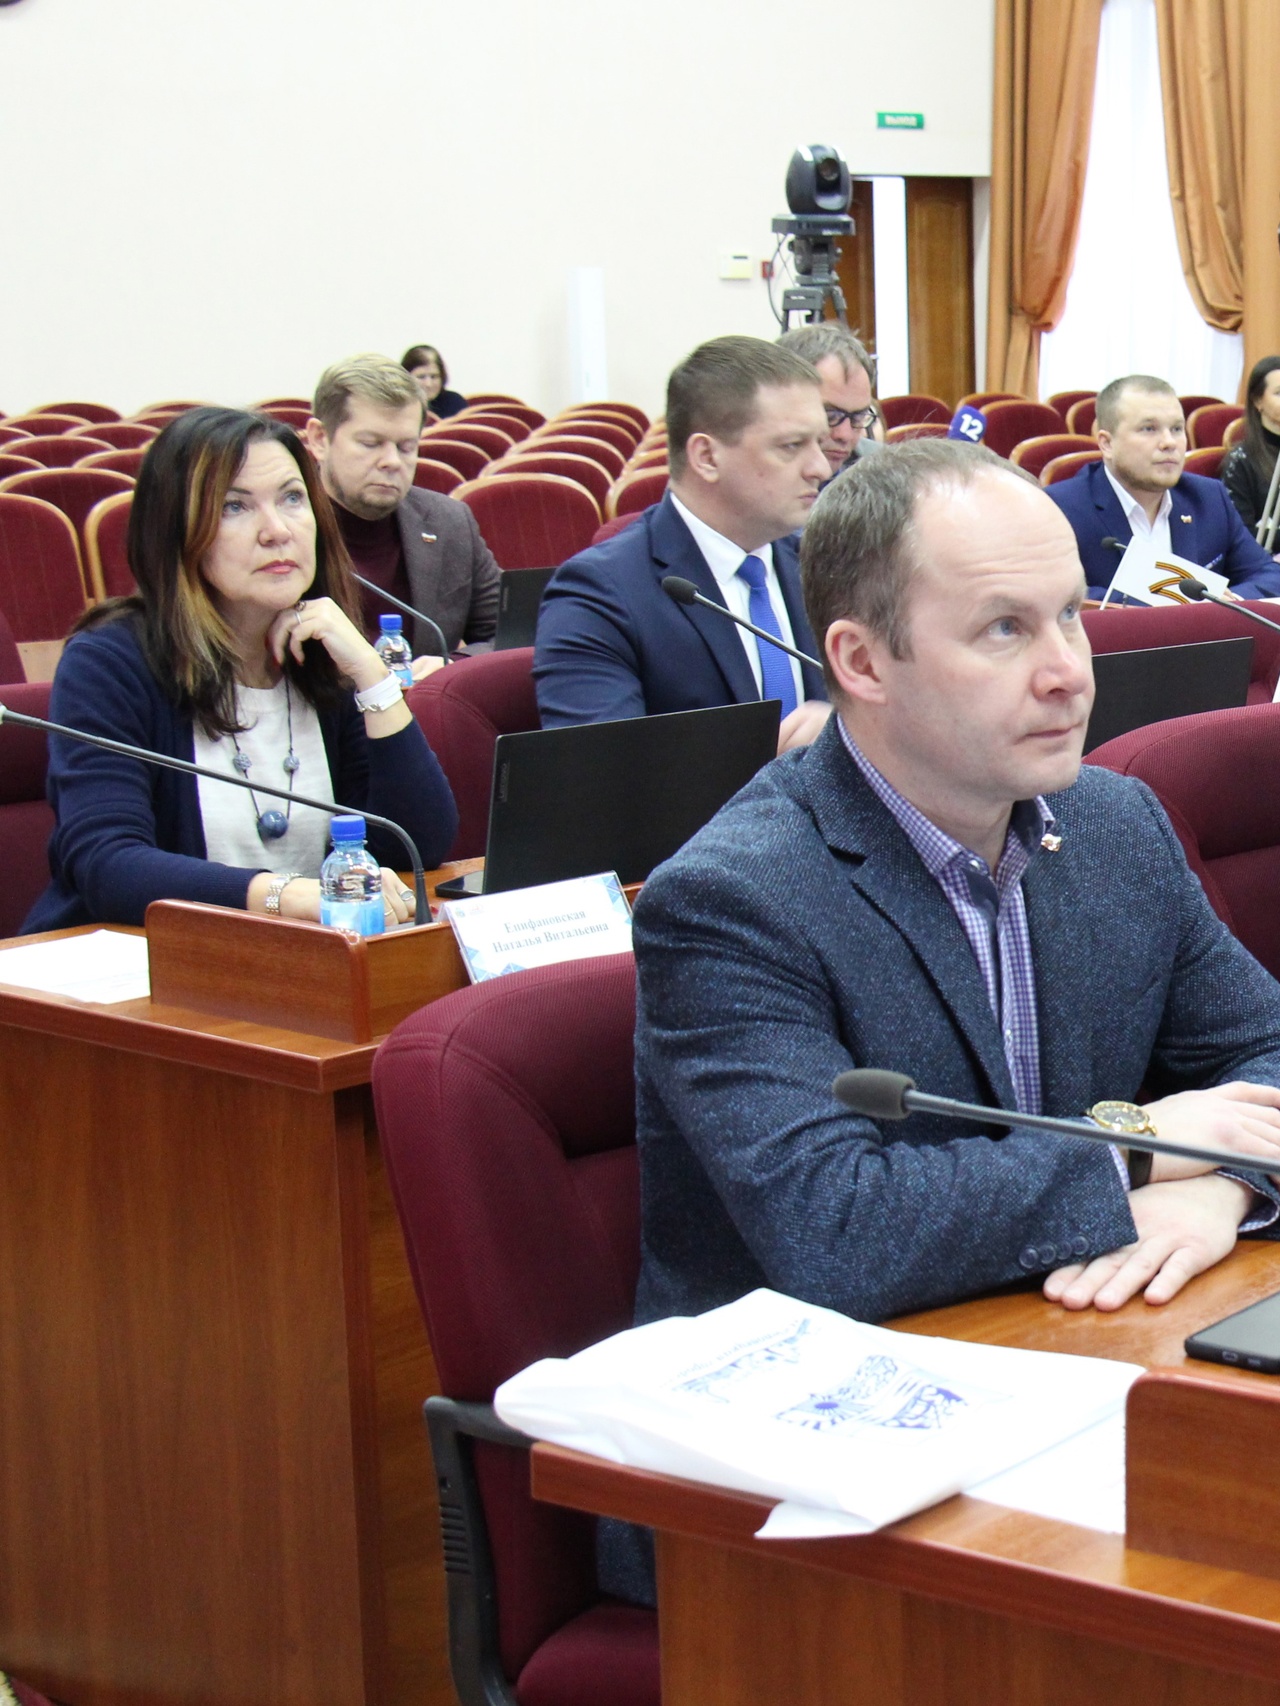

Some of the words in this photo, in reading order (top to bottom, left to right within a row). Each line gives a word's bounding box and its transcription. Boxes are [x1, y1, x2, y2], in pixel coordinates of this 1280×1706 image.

[960, 413, 984, 441] 12
[504, 910, 587, 934] Епифановская
[492, 934, 542, 953] Наталья
[544, 922, 609, 944] Витальевна
